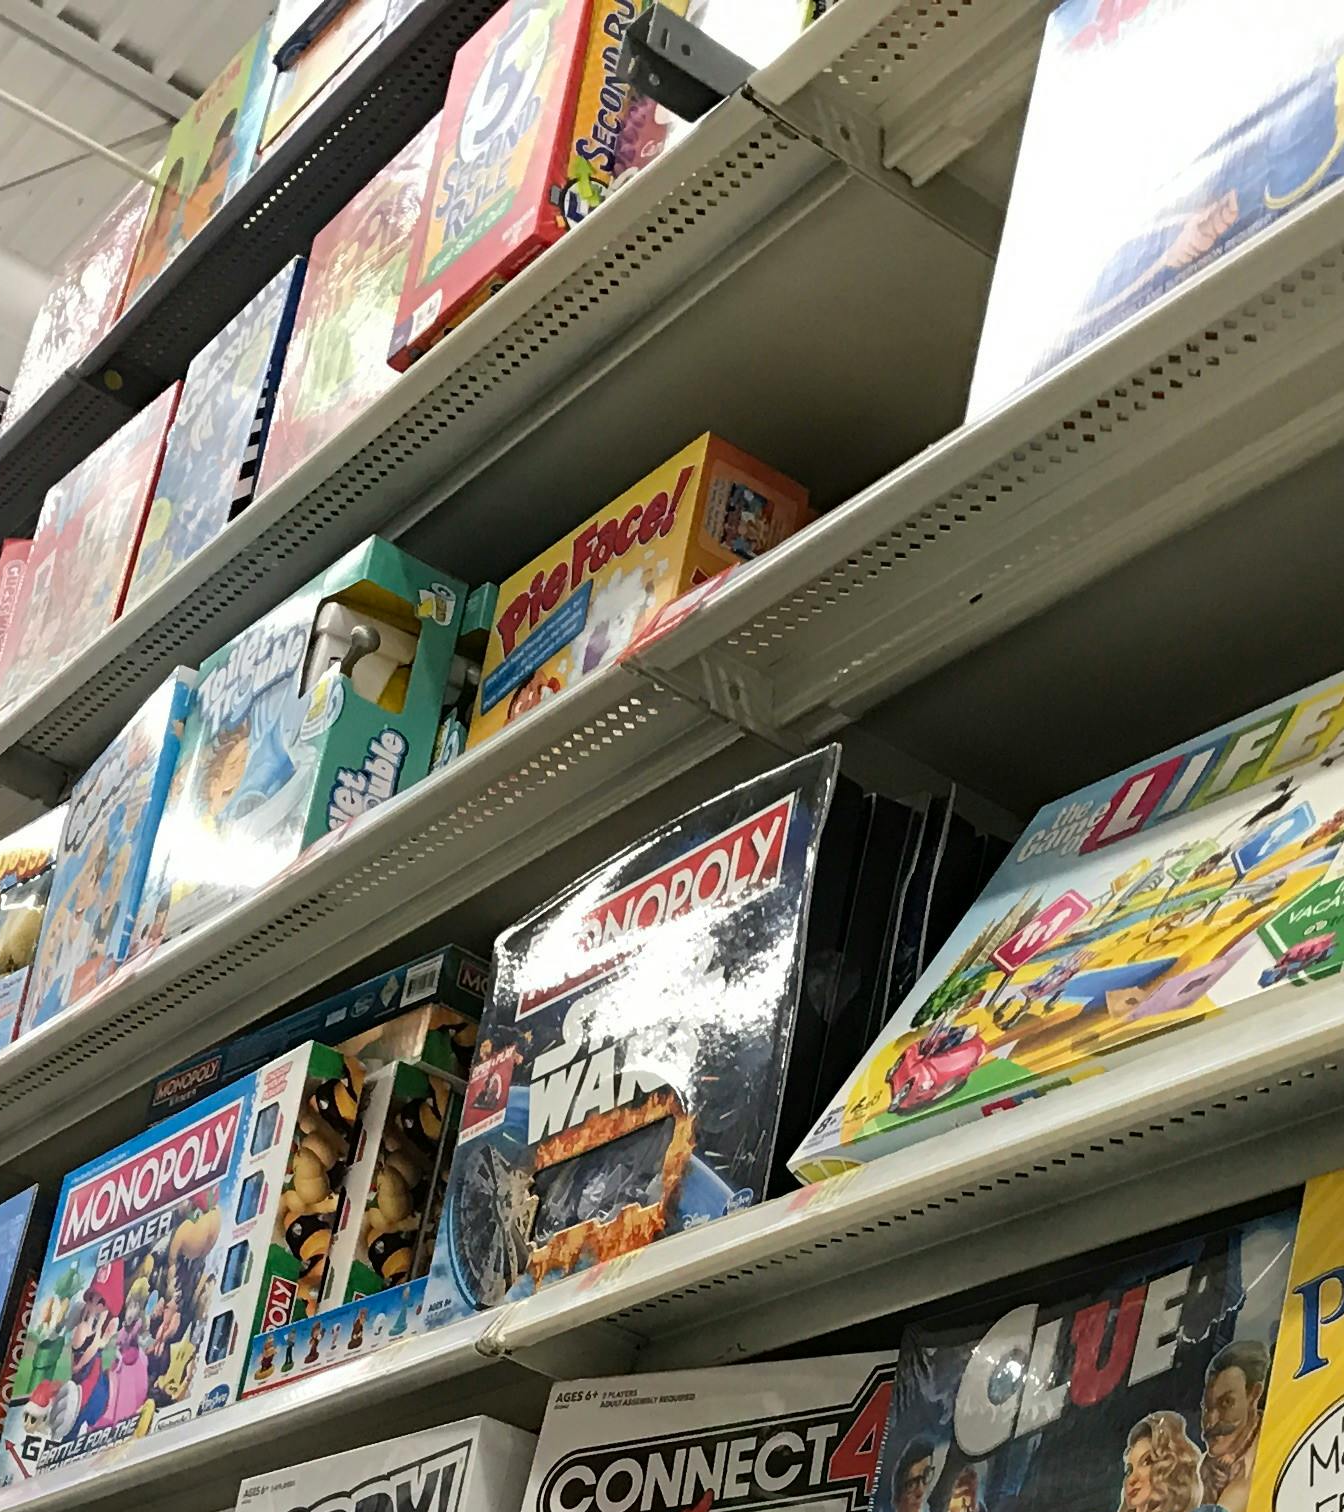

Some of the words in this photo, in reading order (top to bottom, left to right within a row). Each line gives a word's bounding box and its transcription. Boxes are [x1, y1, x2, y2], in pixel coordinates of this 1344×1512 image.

[435, 96, 540, 219] SECOND
[576, 46, 630, 173] SECOND
[443, 158, 513, 244] RULE
[497, 562, 569, 658] Pie
[571, 465, 695, 590] Face!
[60, 1113, 237, 1247] MONOPOLY
[95, 1212, 173, 1265] GAMER
[556, 1391, 584, 1403] AGES
[585, 1390, 599, 1401] 6+
[954, 1266, 1194, 1456] CLUE
[39, 1438, 84, 1467] BATTLE
[829, 1381, 894, 1497] 4
